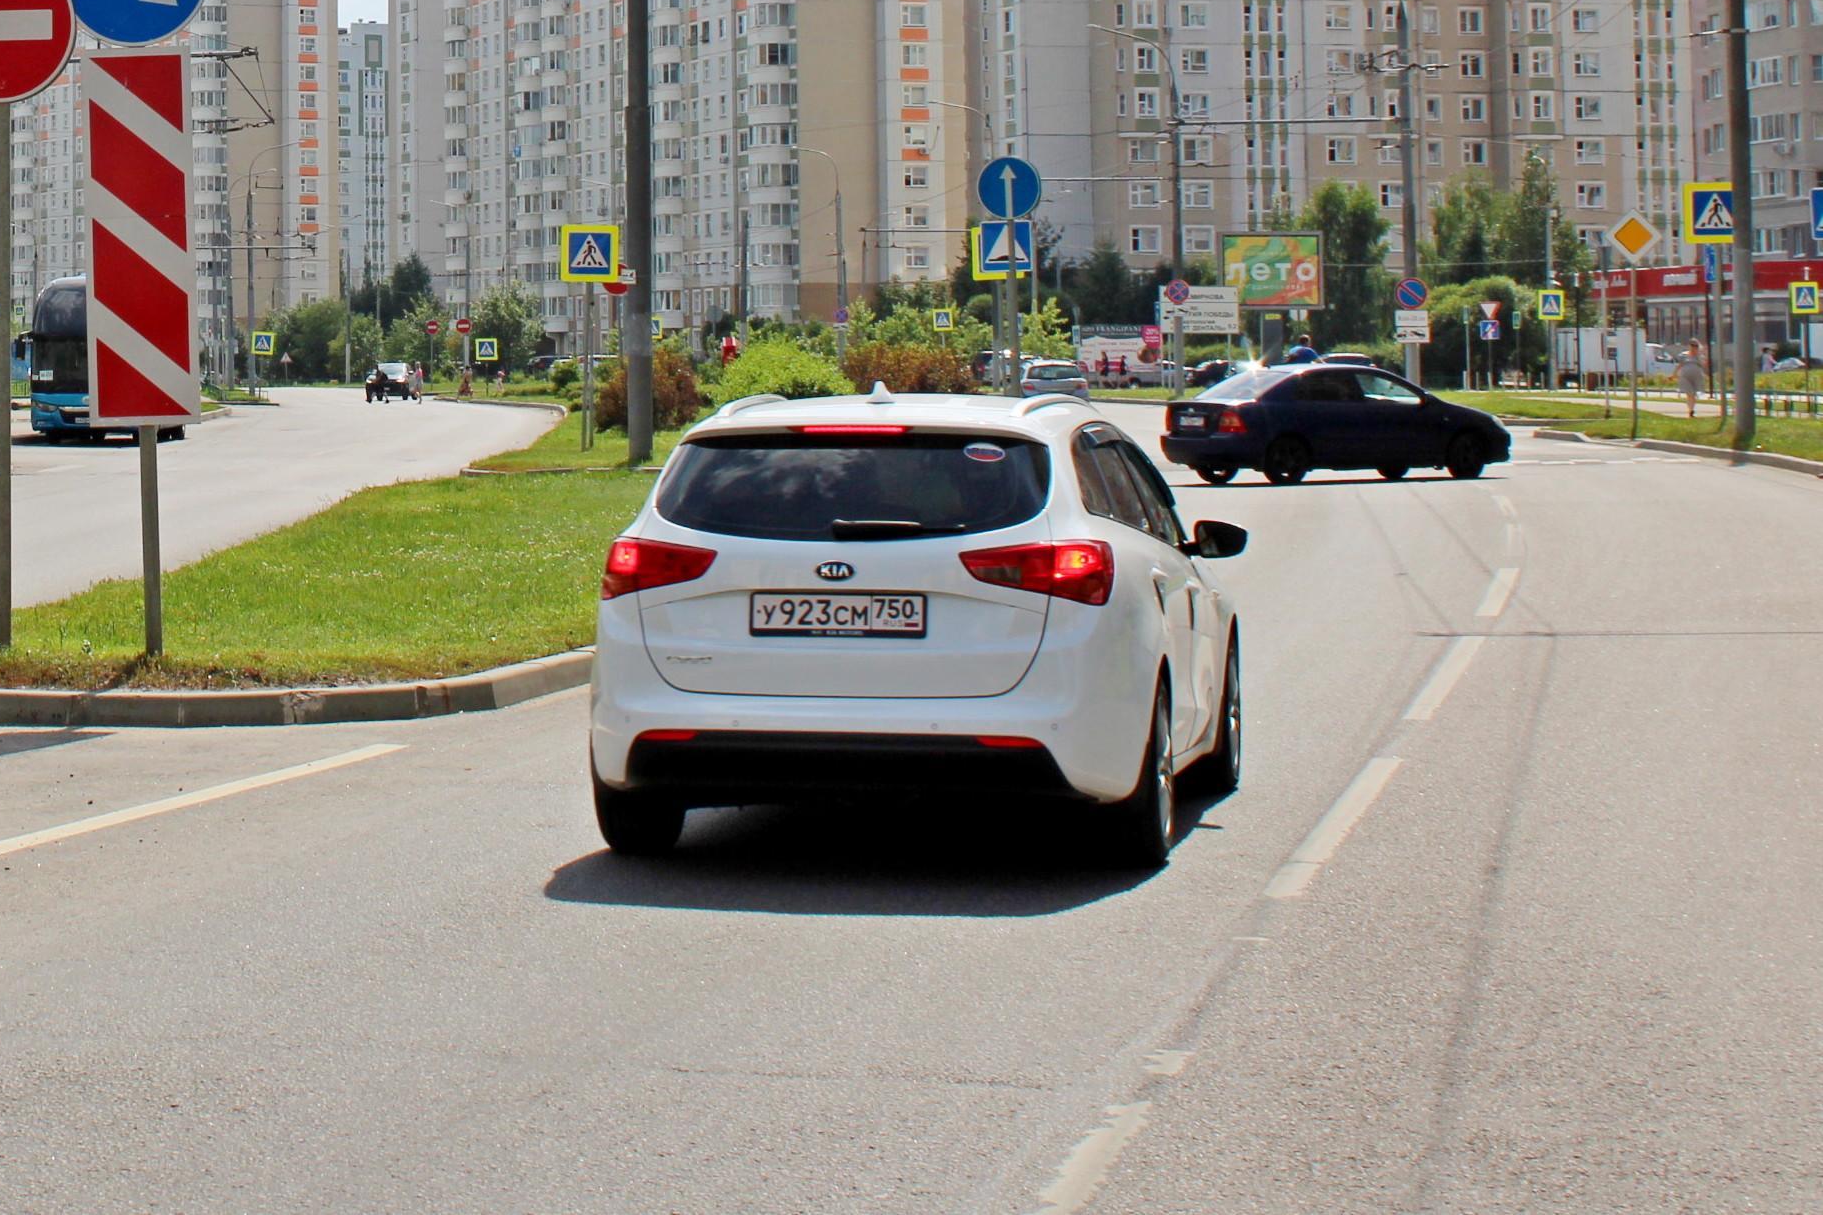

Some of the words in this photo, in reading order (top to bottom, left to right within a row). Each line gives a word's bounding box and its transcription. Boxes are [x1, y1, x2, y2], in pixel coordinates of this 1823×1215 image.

[820, 564, 850, 577] KIA
[873, 598, 915, 619] 750
[883, 619, 904, 627] RUS
